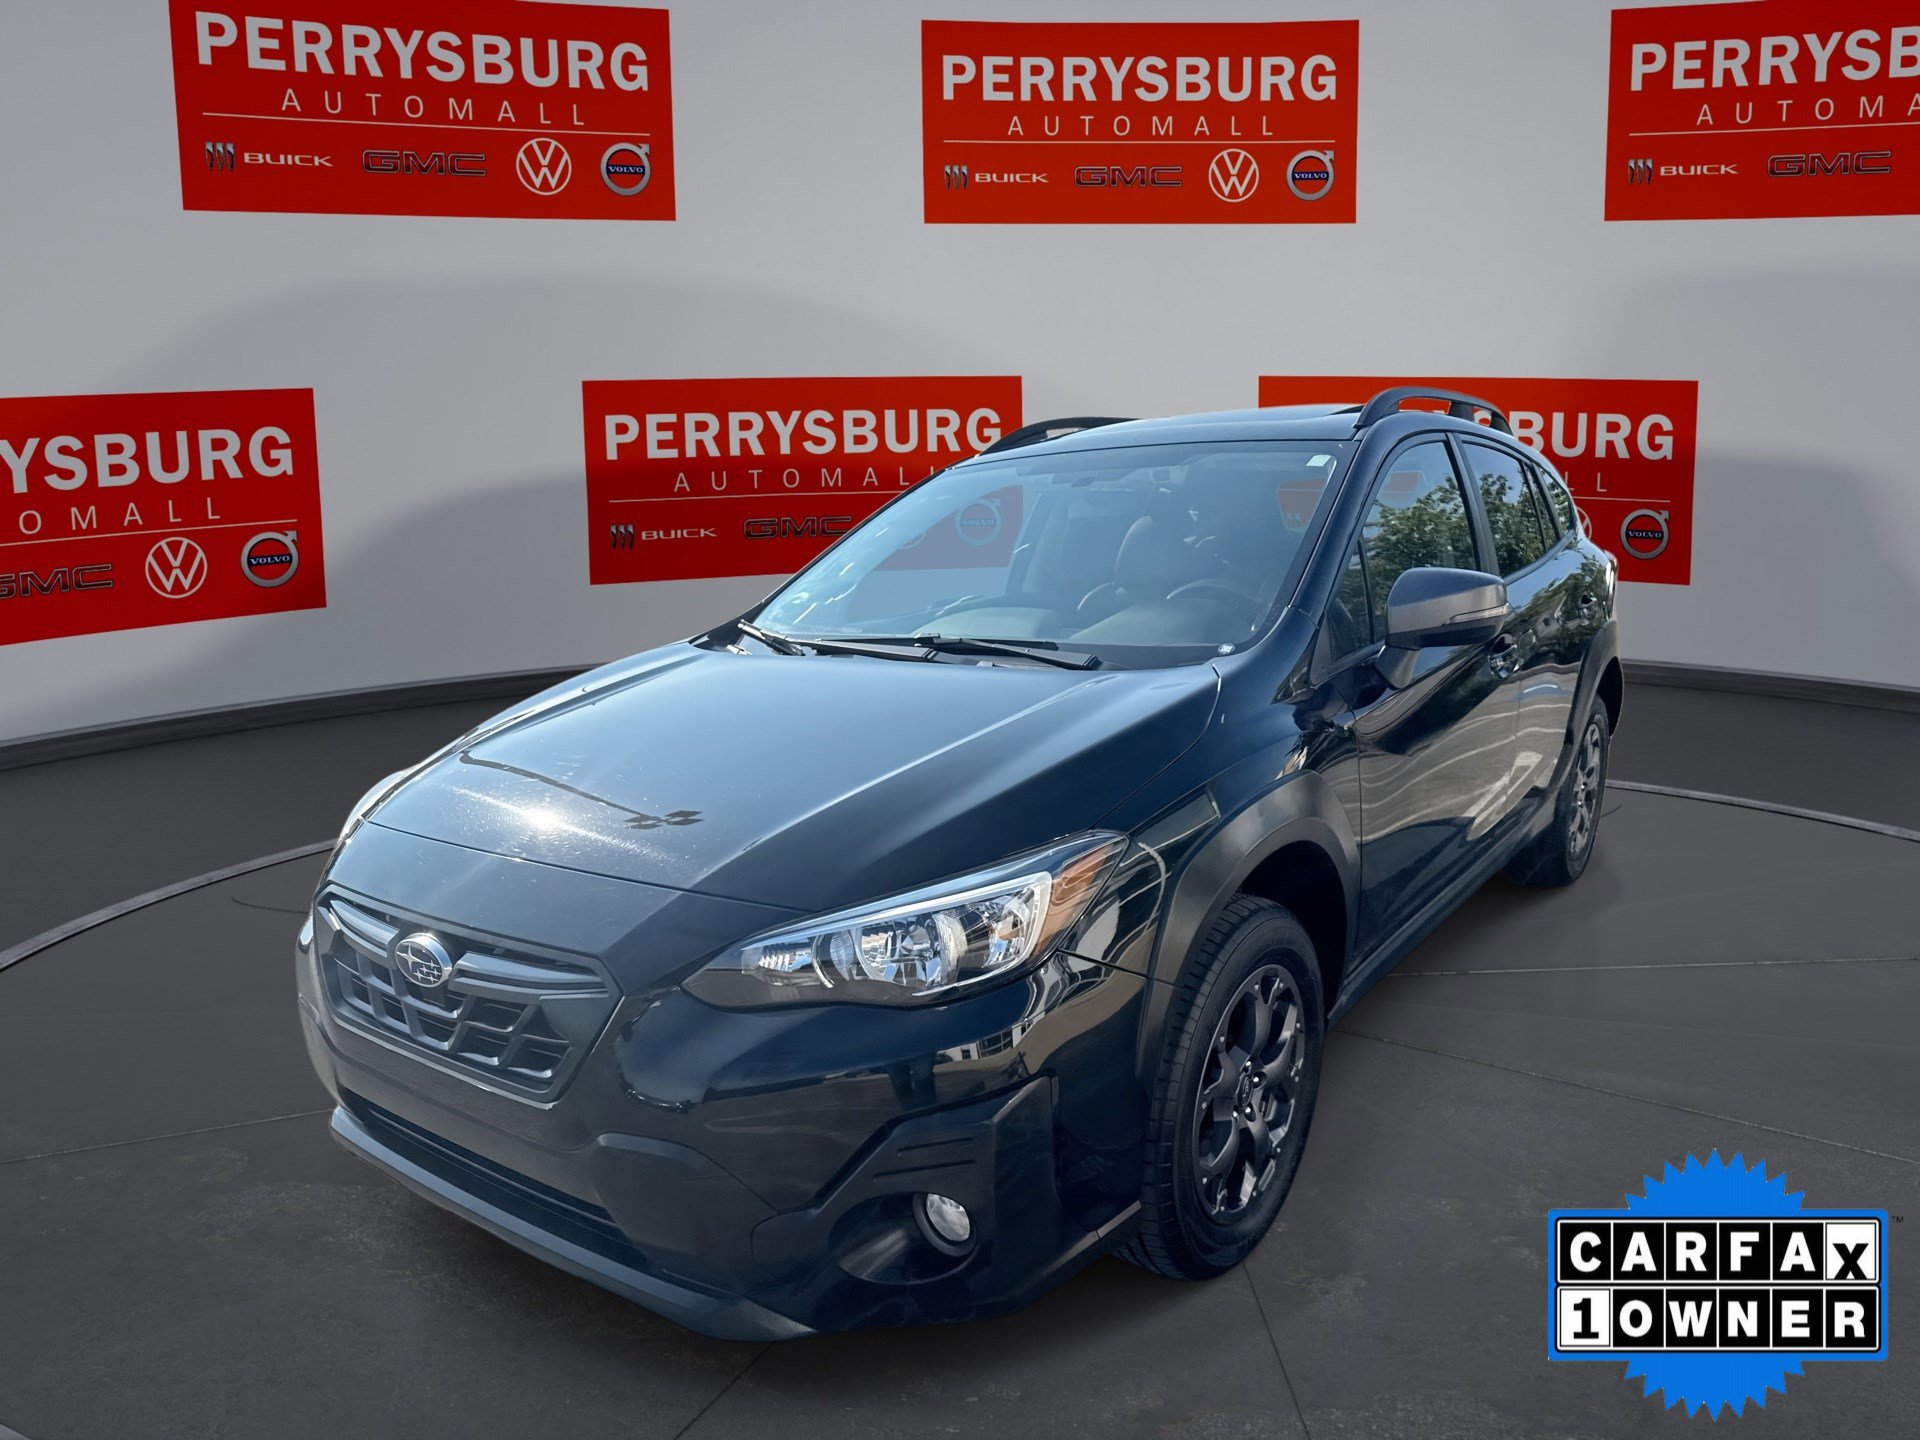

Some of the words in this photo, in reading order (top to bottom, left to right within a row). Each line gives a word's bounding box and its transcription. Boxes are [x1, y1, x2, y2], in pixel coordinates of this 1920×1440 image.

[195, 11, 650, 91] PERRYSBURG
[1630, 25, 1920, 92] PERRYSB
[942, 54, 1337, 102] PERRYSBURG
[281, 88, 585, 126] AUTOMALL
[1007, 115, 1273, 136] AUTOMALL
[243, 151, 334, 167] BUICK
[361, 148, 487, 177] GMC
[609, 165, 643, 174] VOLVO
[1659, 164, 1739, 176] BUICK
[1767, 150, 1892, 177] GMC
[974, 172, 1049, 183] BUICK
[1074, 165, 1182, 188] GMC
[1293, 171, 1328, 180] VOLVO
[604, 408, 1001, 461] PERRYSBURG
[0, 426, 294, 494] YSBURG
[18, 497, 221, 535] OMALL
[743, 515, 852, 540] GMC
[641, 527, 717, 541] BUICK
[1628, 530, 1663, 538] VOLVO
[250, 554, 291, 565] VOLVO
